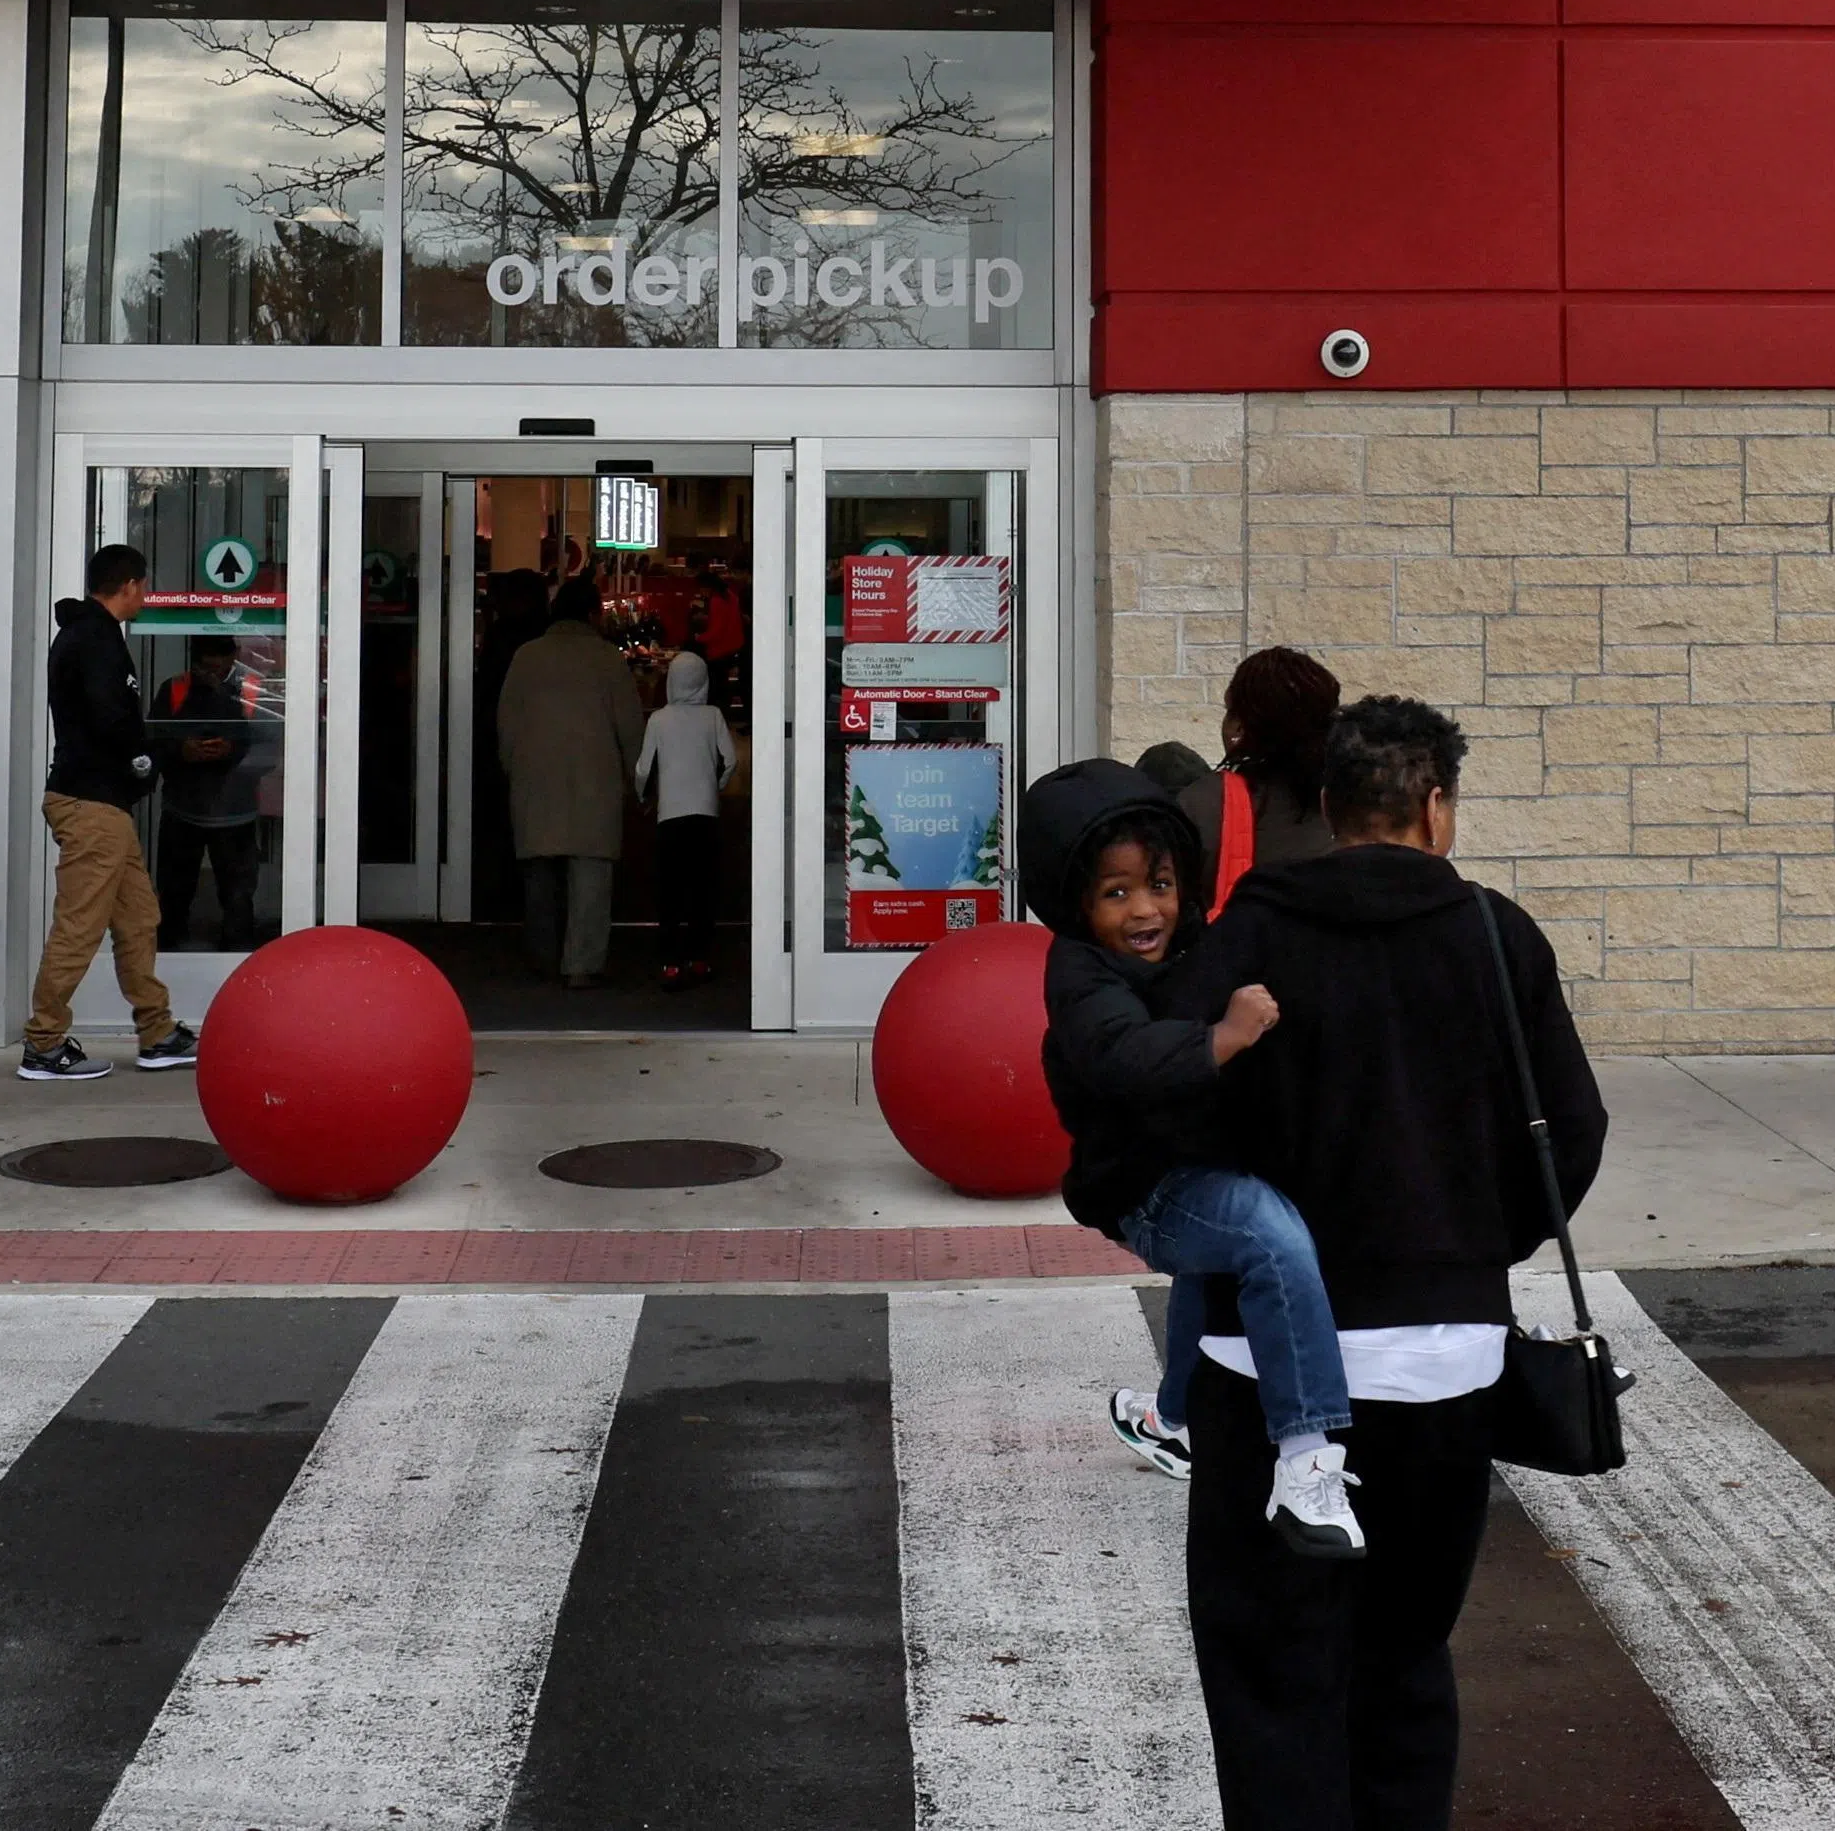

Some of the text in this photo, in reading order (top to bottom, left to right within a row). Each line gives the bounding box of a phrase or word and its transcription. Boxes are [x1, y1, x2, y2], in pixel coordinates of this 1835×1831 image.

[485, 237, 1024, 323] order pickup
[851, 566, 894, 579] Holiday
[851, 578, 883, 589] Store
[143, 595, 187, 604] utomatic
[189, 595, 213, 604] Door
[221, 595, 249, 604] Stand
[251, 595, 277, 605] Clear
[851, 590, 886, 600] Hours
[853, 689, 902, 699] Automatic
[903, 690, 926, 699] Door
[934, 689, 962, 699] Stand
[963, 689, 989, 699] Clear
[903, 764, 944, 788] join
[895, 793, 953, 809] team
[889, 814, 959, 837] Target
